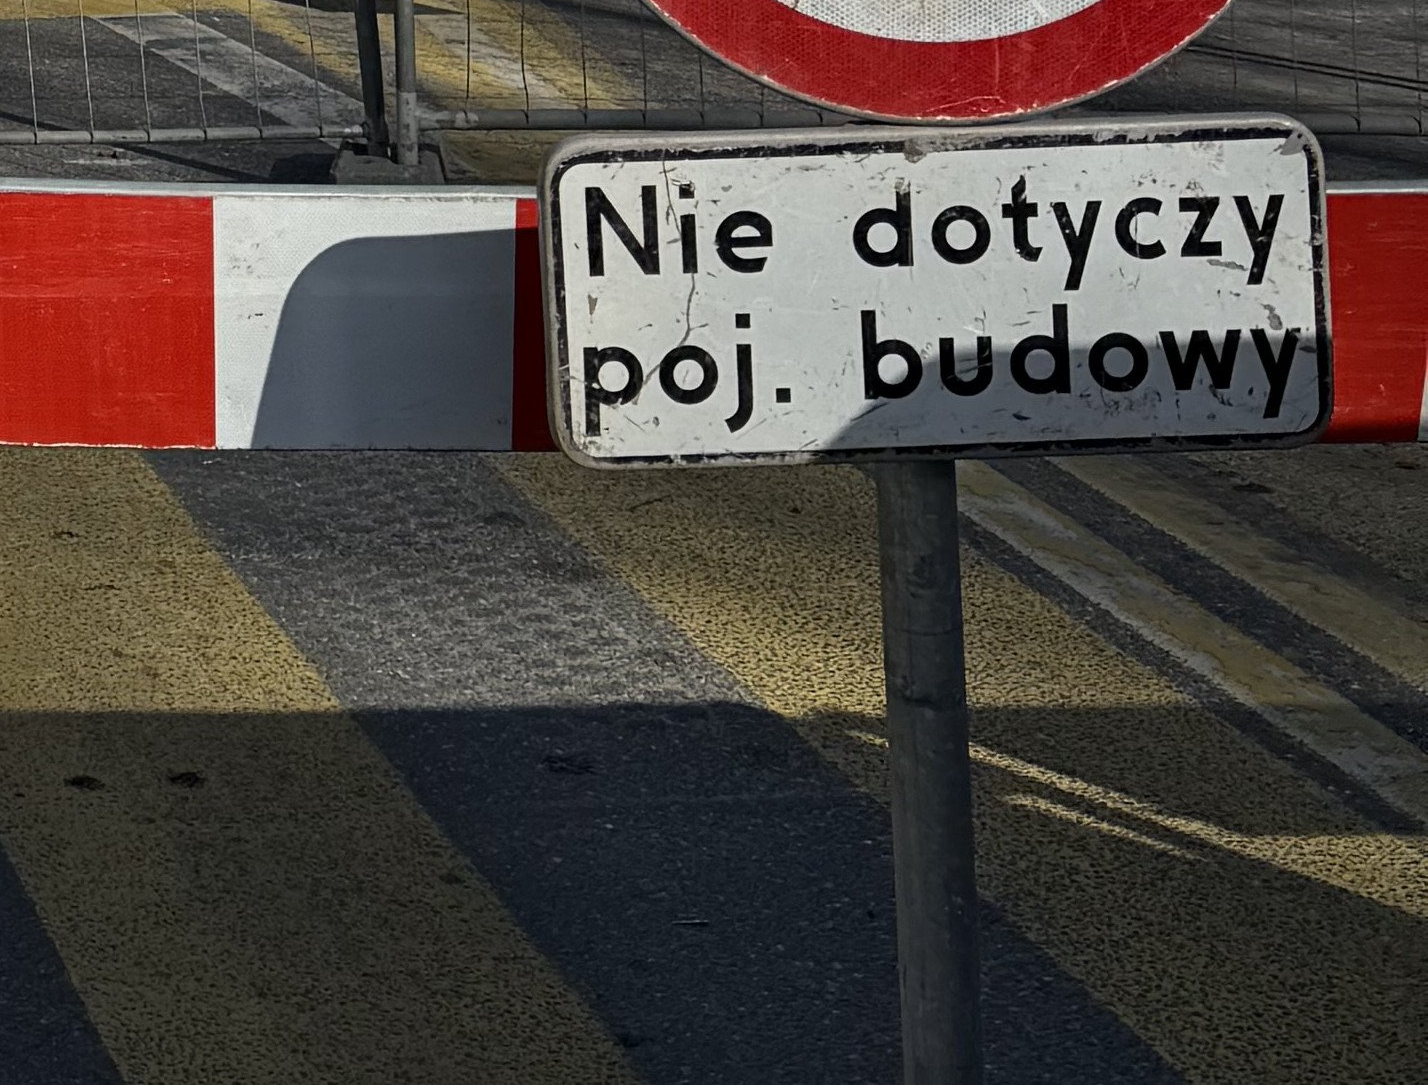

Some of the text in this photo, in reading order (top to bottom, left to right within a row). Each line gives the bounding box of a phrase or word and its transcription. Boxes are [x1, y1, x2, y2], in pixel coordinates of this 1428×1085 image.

[584, 173, 1286, 291] Nie dotyczy
[582, 303, 1302, 437] poj. budowy
